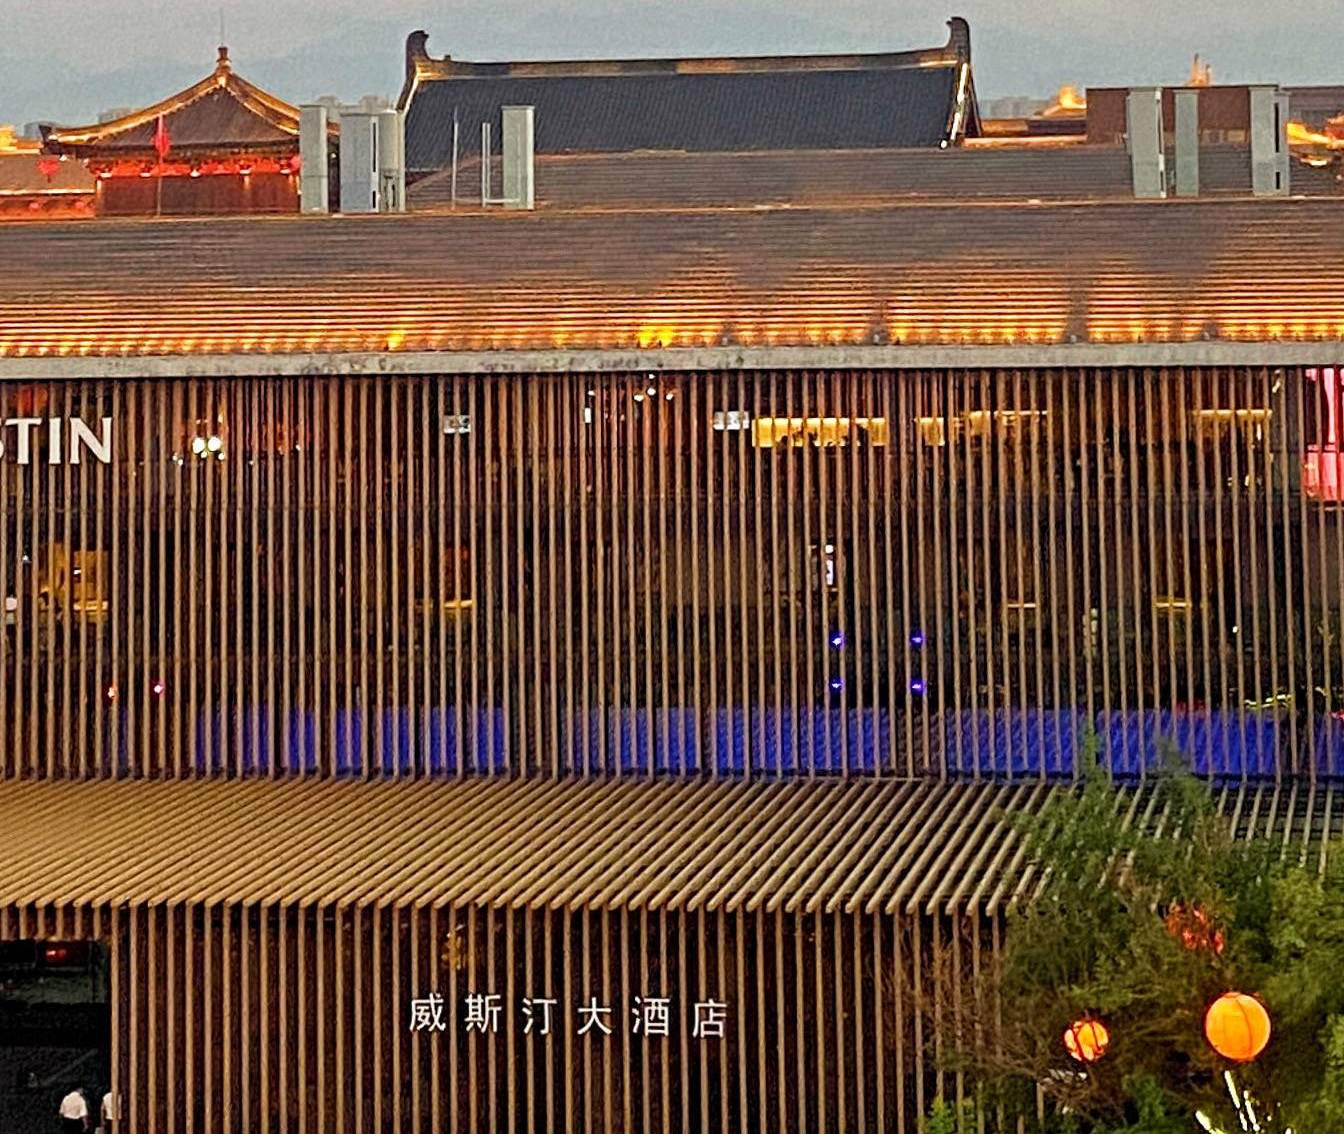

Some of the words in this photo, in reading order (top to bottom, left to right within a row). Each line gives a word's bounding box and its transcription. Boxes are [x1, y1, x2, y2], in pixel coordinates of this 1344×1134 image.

[409, 993, 727, 1038] 威斯汀大酒店
